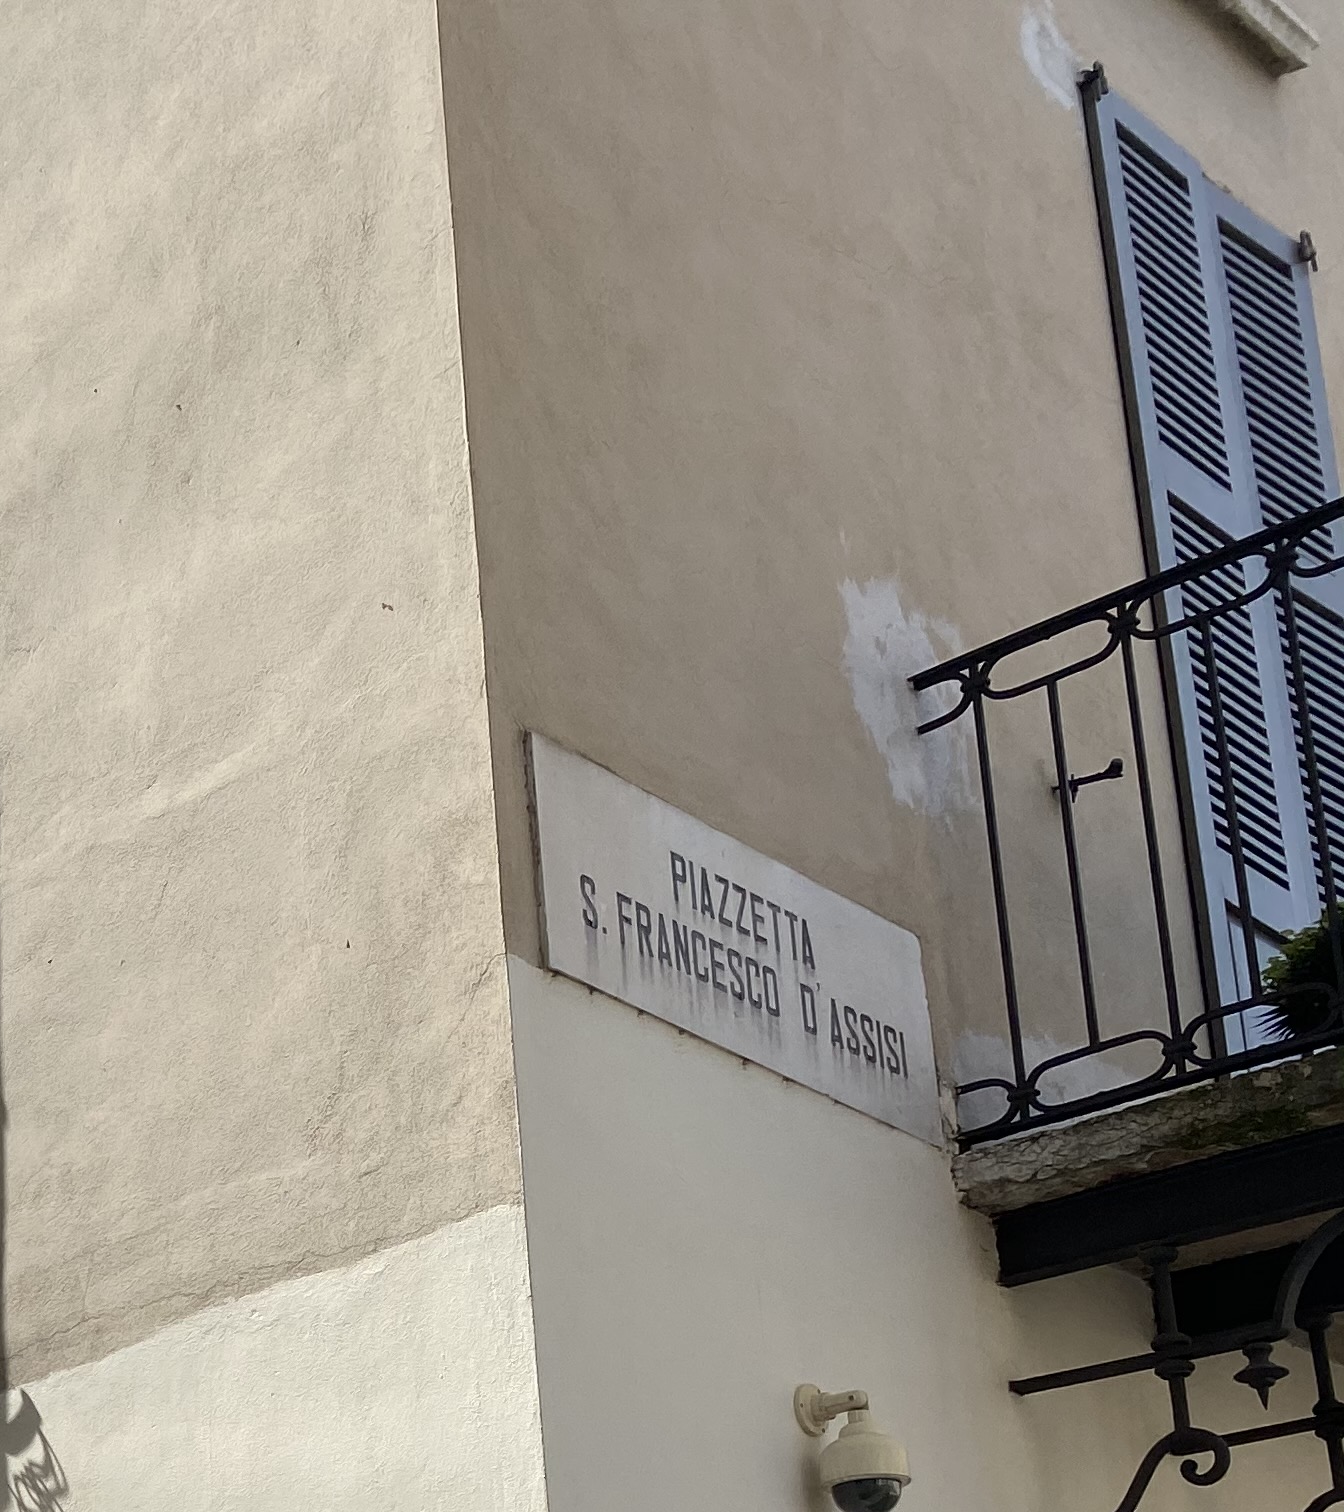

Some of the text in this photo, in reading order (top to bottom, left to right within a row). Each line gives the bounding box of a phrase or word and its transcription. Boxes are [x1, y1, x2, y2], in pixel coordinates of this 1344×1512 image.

[579, 873, 608, 935] S.
[616, 891, 781, 1018] FRANCESCO
[670, 850, 816, 970] PIAZZETTA
